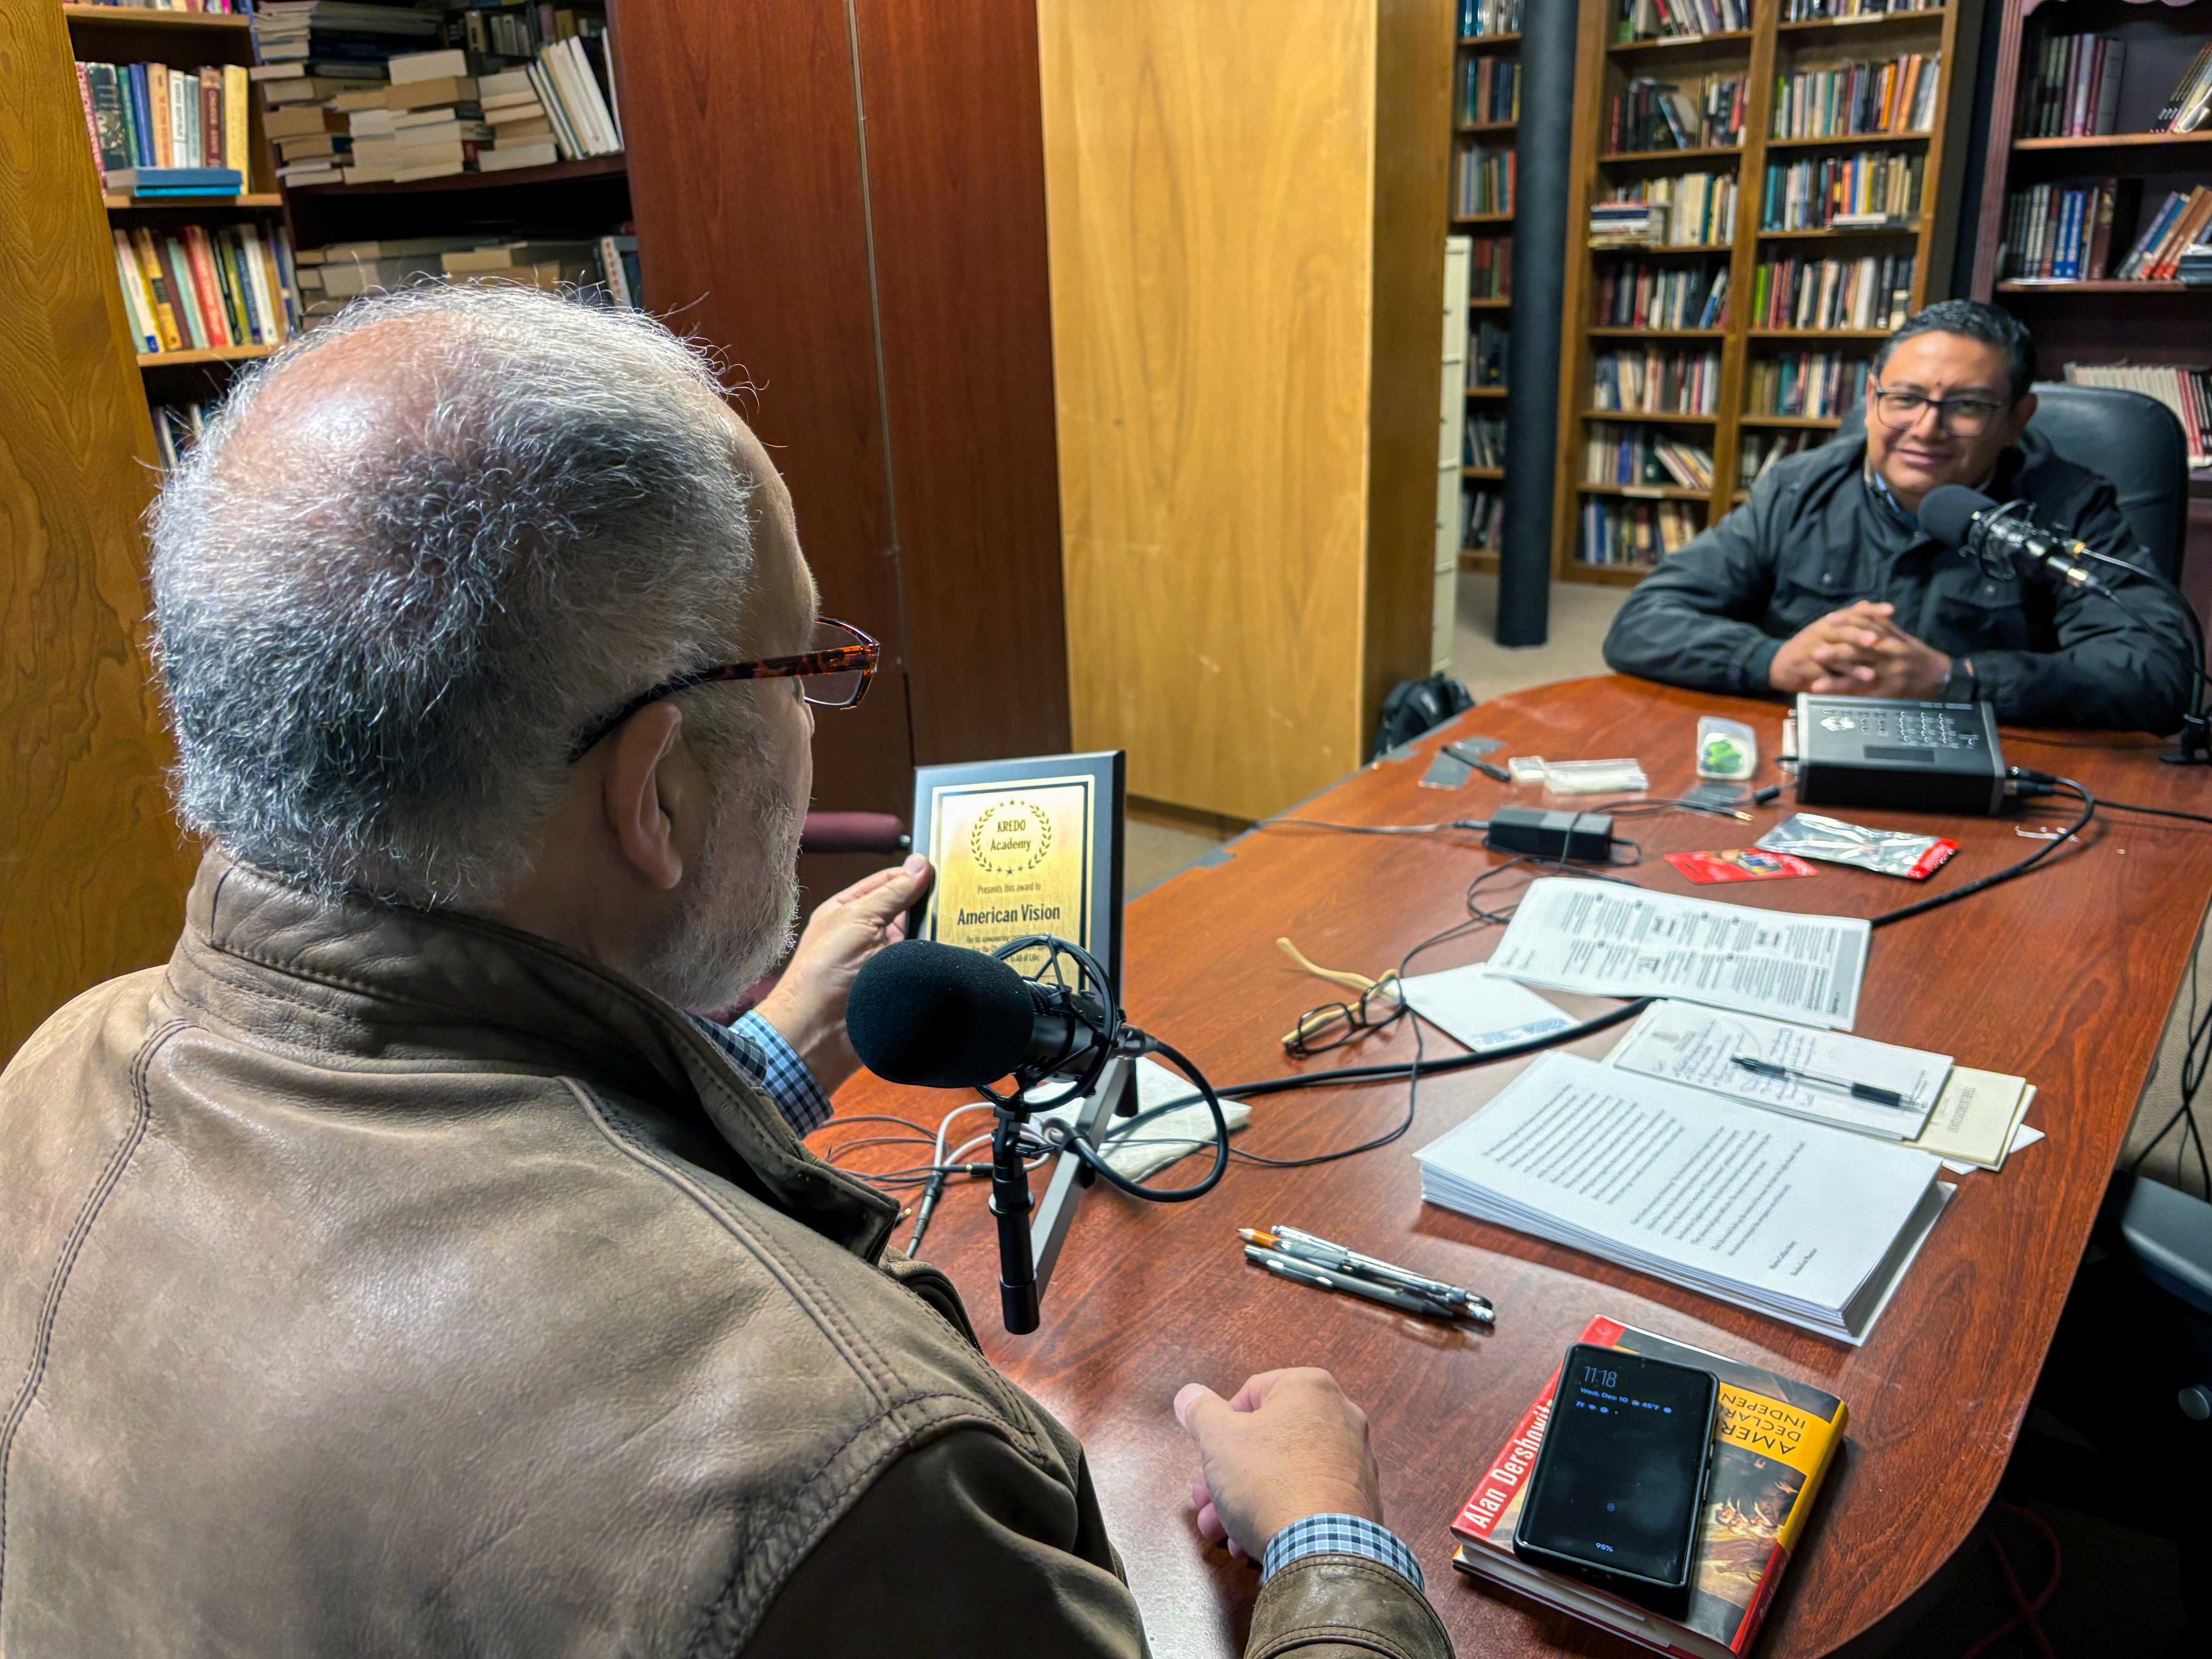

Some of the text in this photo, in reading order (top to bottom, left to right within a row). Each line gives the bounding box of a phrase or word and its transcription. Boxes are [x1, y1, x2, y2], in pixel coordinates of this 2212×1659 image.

[997, 819, 1026, 832] KREDO
[990, 838, 1031, 852] Academy
[978, 881, 1041, 893] Presents this award to
[957, 903, 1060, 926] American Vision
[1585, 1366, 1618, 1388] 11:18
[1601, 1392, 1618, 1401] Dec
[1721, 1393, 1806, 1429] INDEPEN
[1721, 1421, 1796, 1455] AMER
[1462, 1399, 1553, 1529] Alan Dershowit
